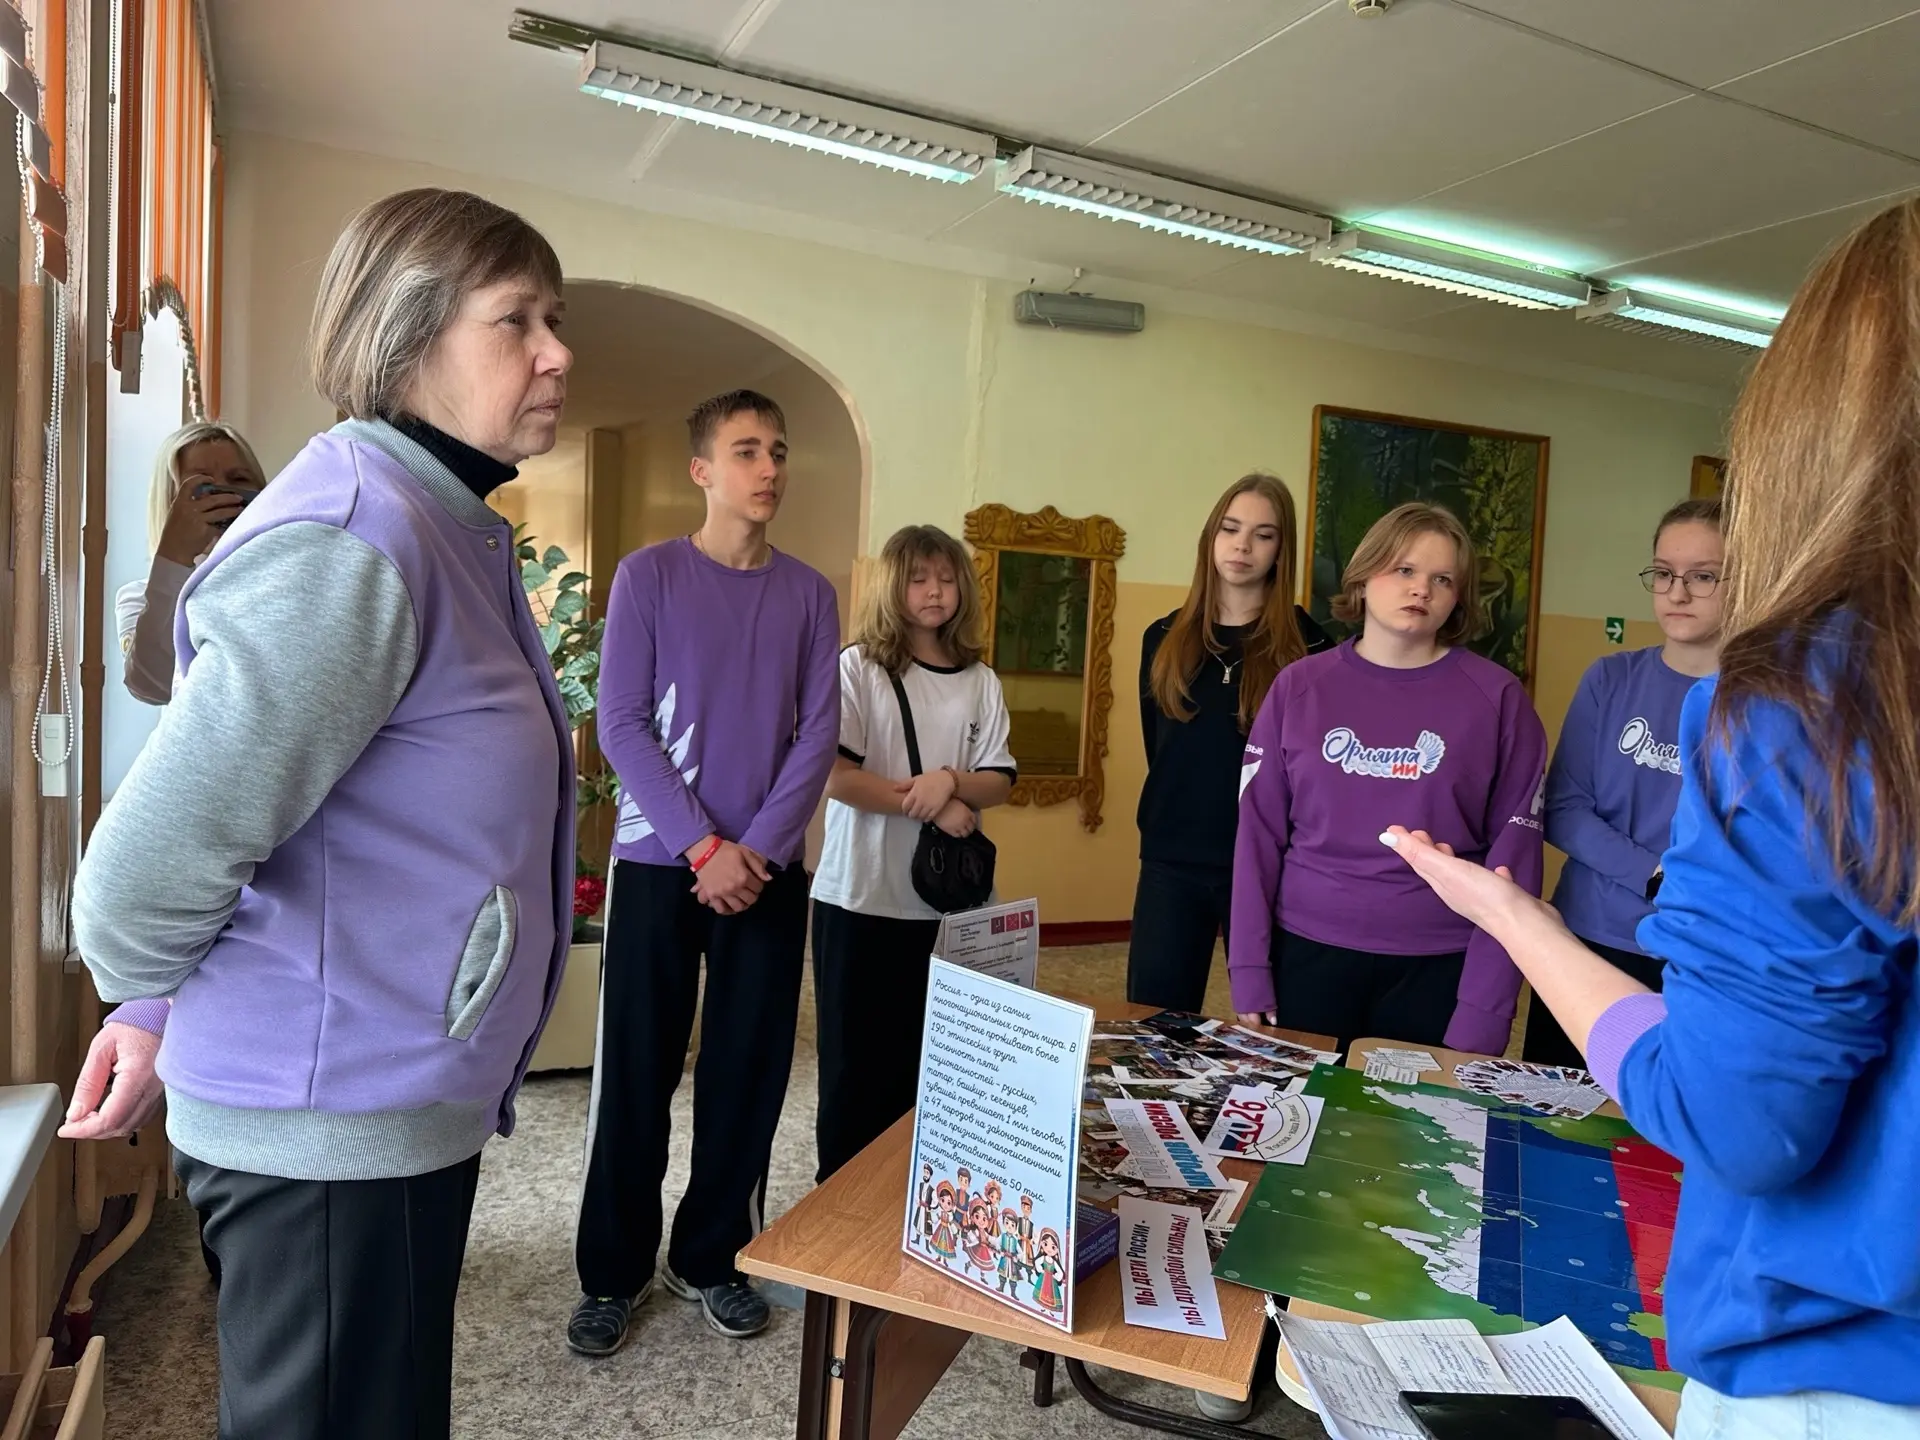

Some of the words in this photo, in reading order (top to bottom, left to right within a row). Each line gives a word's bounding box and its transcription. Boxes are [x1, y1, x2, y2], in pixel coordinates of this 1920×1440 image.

[1324, 728, 1421, 766] Орлята
[1619, 718, 1680, 758] Орля
[935, 979, 961, 996] Россия
[970, 994, 990, 1006] одна
[1003, 1005, 1031, 1020] самых
[931, 1022, 945, 1034] 190
[947, 1031, 991, 1053] этнических
[993, 1049, 1017, 1064] групп.
[932, 1010, 955, 1024] нашей
[957, 1019, 985, 1035] стране
[985, 1031, 1034, 1054] проживает
[1035, 1046, 1060, 1063] более
[933, 996, 1011, 1029] многонациональных
[1013, 1025, 1040, 1040] стран
[1041, 1035, 1066, 1050] мира.
[931, 1036, 975, 1062] Численность
[976, 1058, 999, 1072] пяти
[927, 1067, 954, 1086] татар,
[957, 1078, 987, 1100] башкир,
[990, 1094, 1028, 1118] чеченцев,
[928, 1053, 994, 1085] национальностей
[1001, 1084, 1037, 1105] русских,
[926, 1081, 957, 1100] чувашей
[957, 1096, 1005, 1122] превышает
[1012, 1120, 1029, 1132] млн
[1031, 1127, 1066, 1149] человек,
[942, 1104, 974, 1123] народов
[987, 1124, 1064, 1163] законодательном
[1141, 1102, 1186, 1141] РОССИИ
[920, 1153, 947, 1172] человек.
[922, 1110, 947, 1126] уровне
[949, 1122, 987, 1145] признаны
[988, 1141, 1061, 1178] малочисленными
[940, 1134, 1006, 1169] представителей
[1163, 1141, 1217, 1188] НАРОДОВ
[920, 1139, 982, 1174] насчитывается
[983, 1170, 1008, 1186] менее
[1023, 1188, 1045, 1203] тыс.
[1166, 1213, 1191, 1256] сильны!
[1129, 1259, 1155, 1287] дети
[1162, 1255, 1199, 1306] дружбой
[1134, 1286, 1159, 1307] Мы
